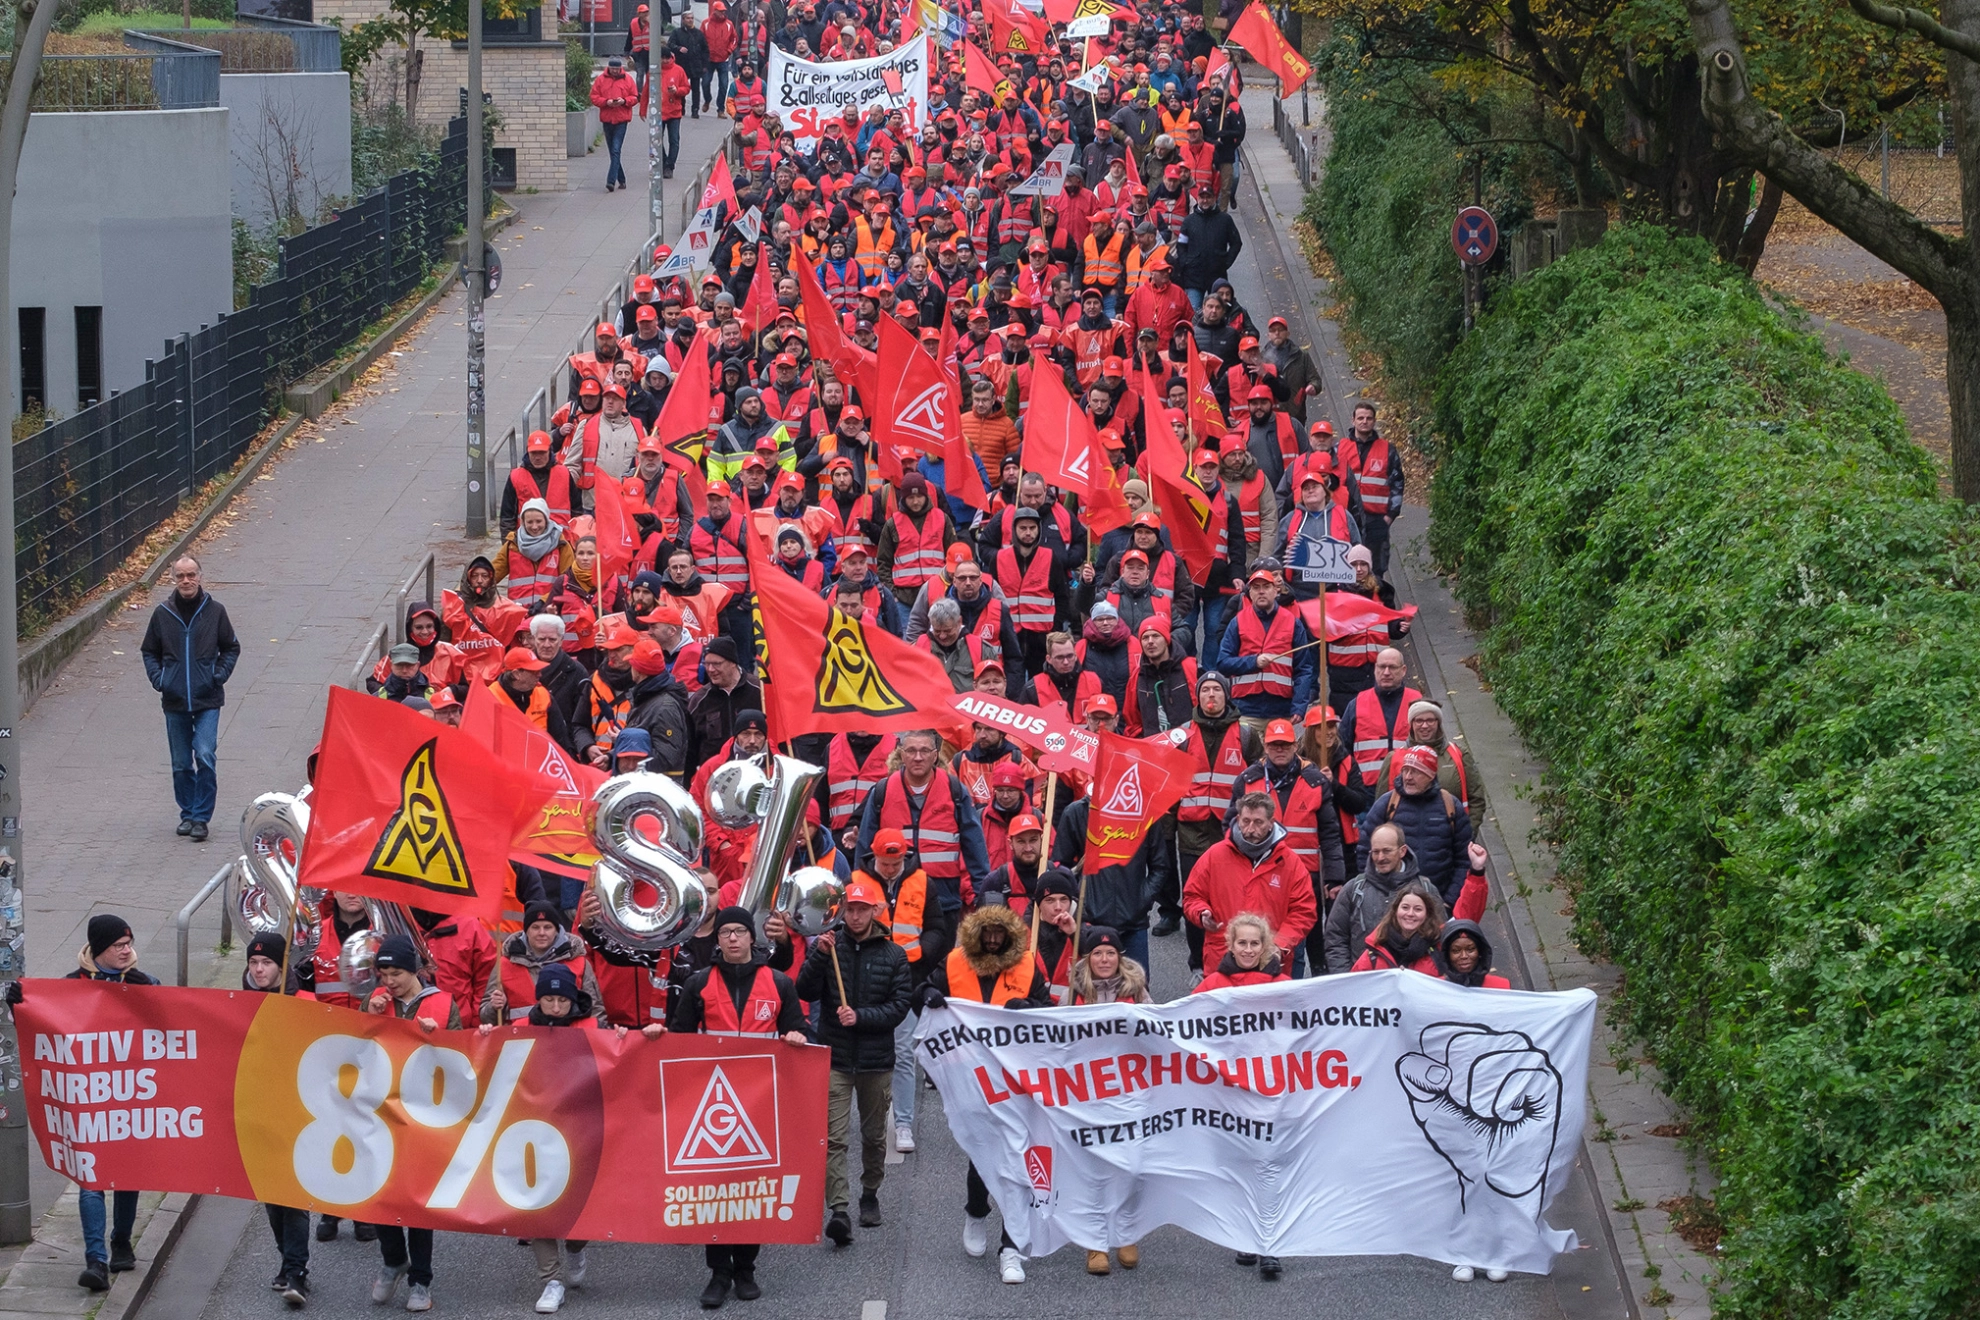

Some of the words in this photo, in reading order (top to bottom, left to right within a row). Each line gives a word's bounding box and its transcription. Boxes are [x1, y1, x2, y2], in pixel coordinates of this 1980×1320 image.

[784, 63, 808, 84] Für
[811, 72, 830, 84] ein
[1303, 569, 1353, 580] Buxtehude
[955, 697, 1047, 735] AIRBUS
[1069, 727, 1099, 746] Hamb
[1133, 1018, 1175, 1040] AUF
[1290, 1005, 1402, 1029] NACKEN?
[34, 1029, 134, 1065] AKTIV
[142, 1029, 197, 1061] BEI
[41, 1068, 158, 1104] AIRBUS
[44, 1103, 204, 1144] HAMBURG
[293, 1033, 571, 1210] 8%
[682, 1078, 762, 1160] IGM
[1141, 1107, 1187, 1138] ERST
[1191, 1107, 1274, 1142] RECHT!
[51, 1139, 97, 1183] FÜR
[664, 1176, 778, 1203] SOLIDARITÄT
